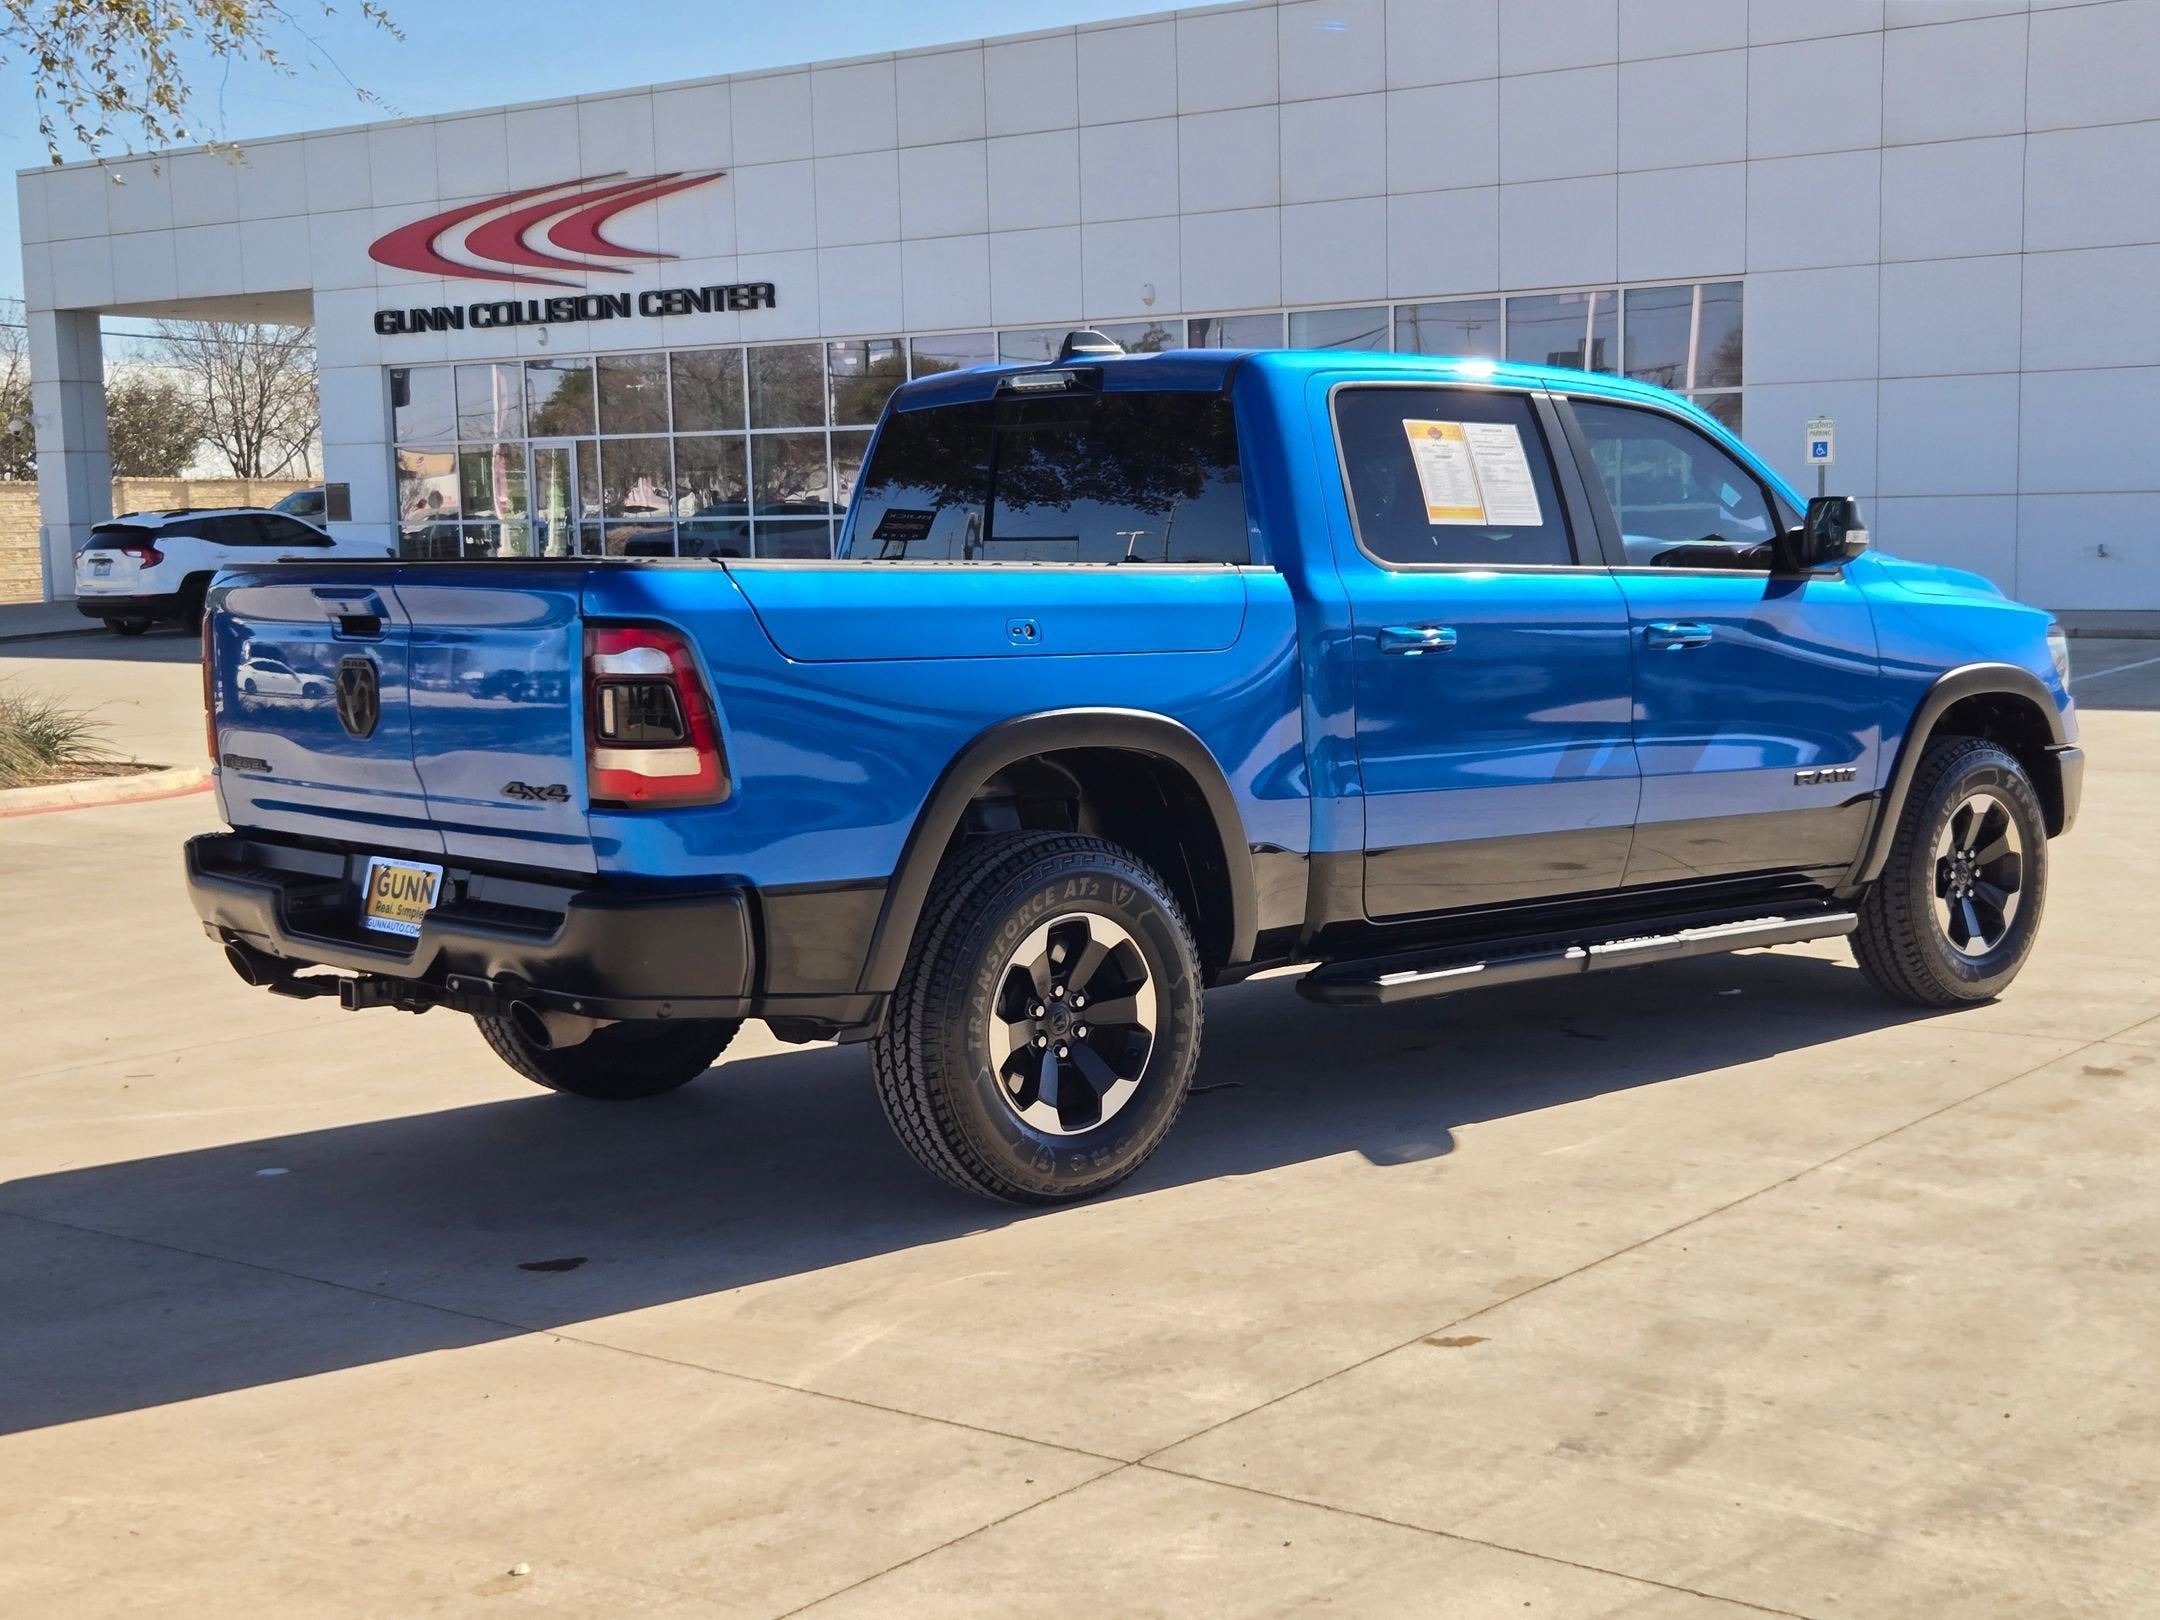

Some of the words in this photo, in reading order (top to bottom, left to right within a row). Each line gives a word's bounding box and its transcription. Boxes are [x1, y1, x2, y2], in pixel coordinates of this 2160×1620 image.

[374, 304, 464, 335] GUNN
[468, 292, 631, 328] COLLISION
[639, 282, 776, 317] CENTER
[1794, 767, 1857, 785] RAM
[377, 871, 436, 905] GUNN
